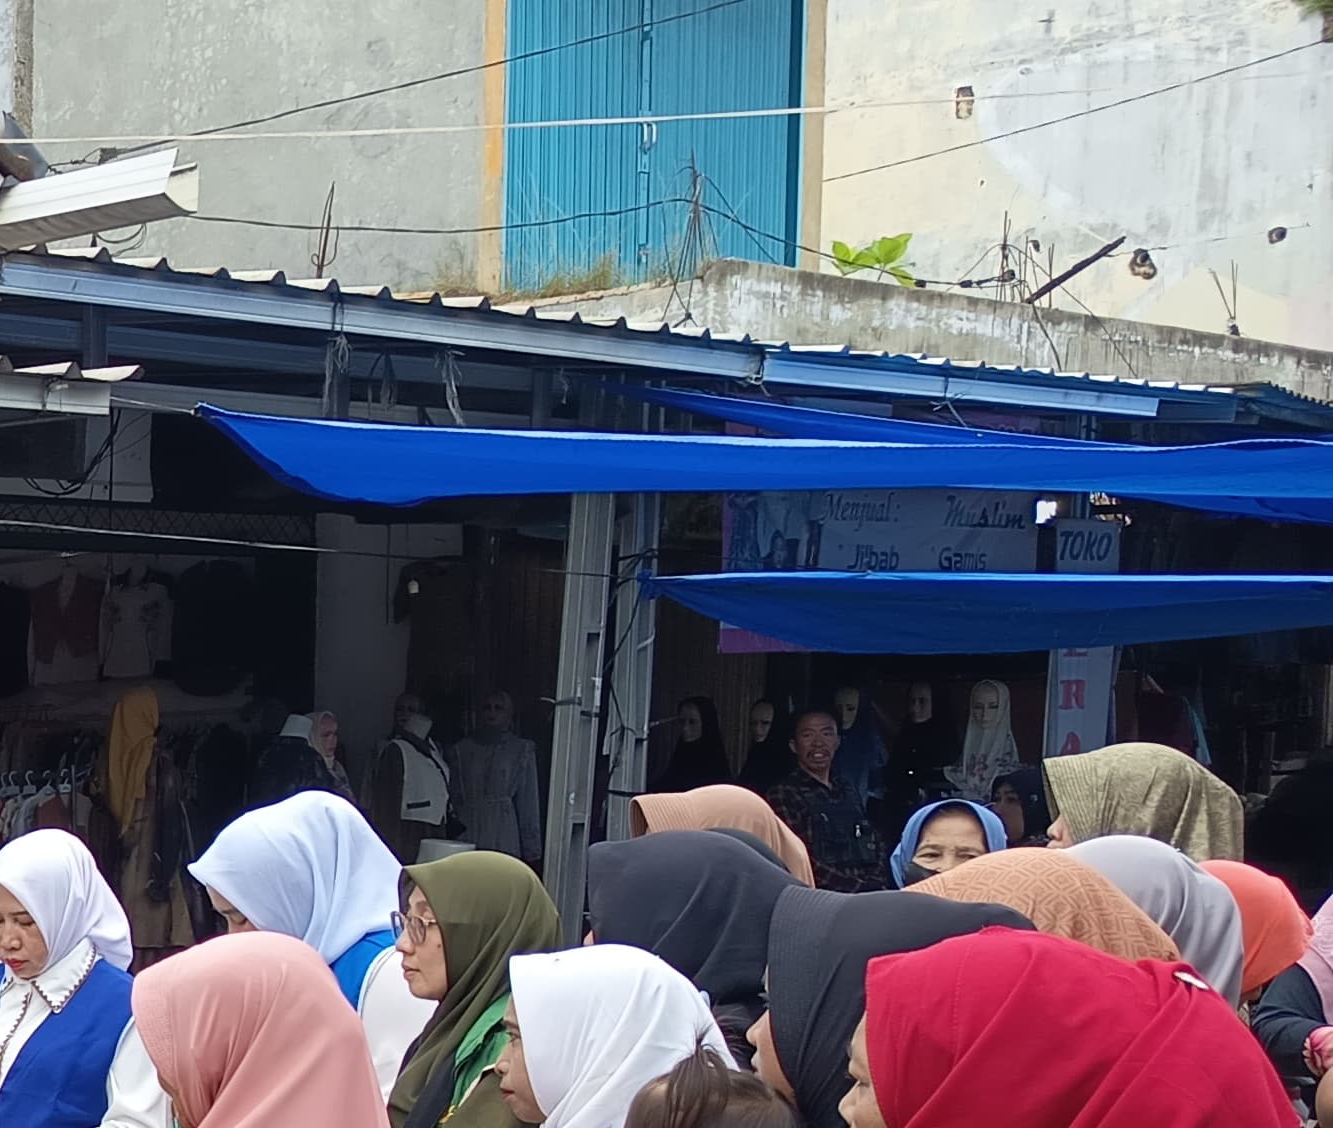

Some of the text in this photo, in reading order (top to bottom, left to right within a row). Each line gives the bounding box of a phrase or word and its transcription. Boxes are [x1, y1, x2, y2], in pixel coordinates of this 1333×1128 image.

[943, 494, 1026, 530] Muslim
[939, 547, 986, 570] Gamis
[1060, 530, 1113, 562] TOKO
